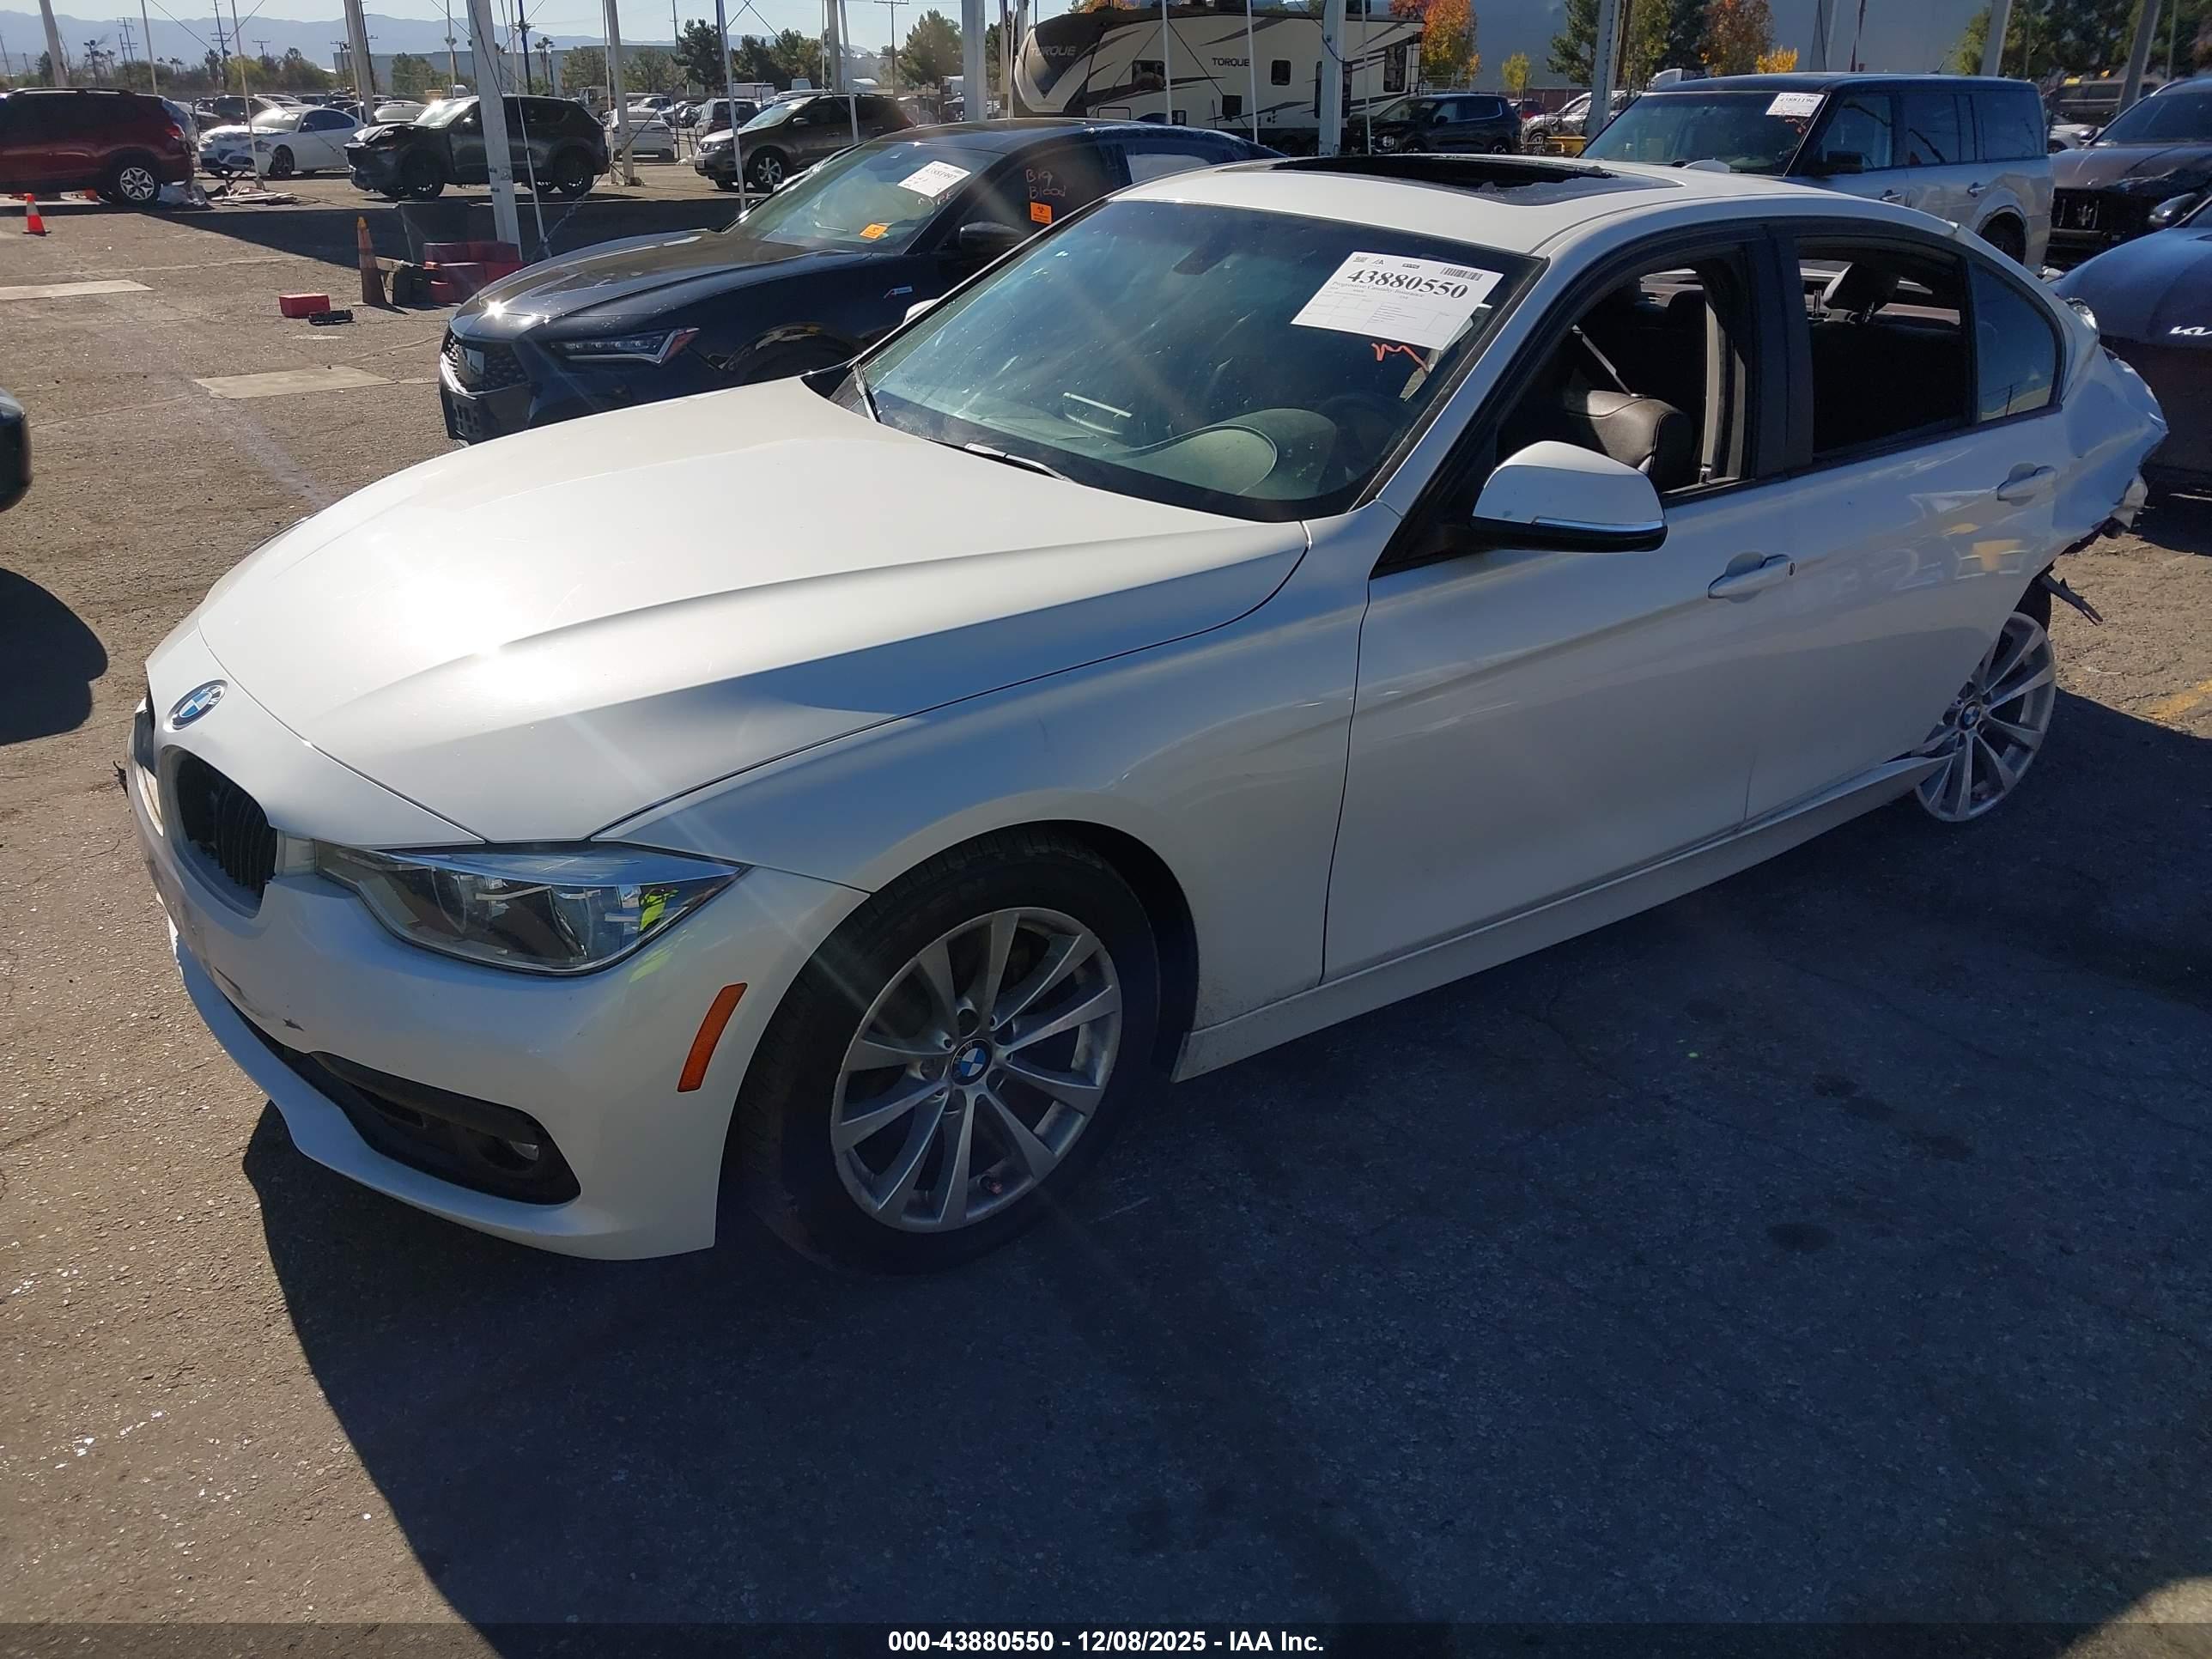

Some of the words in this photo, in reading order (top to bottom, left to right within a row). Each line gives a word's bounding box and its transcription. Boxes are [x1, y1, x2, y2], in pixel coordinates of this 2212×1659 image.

[1030, 46, 1077, 57] TORQUE
[1212, 58, 1250, 67] TORQUE
[1346, 269, 1469, 300] 43880550
